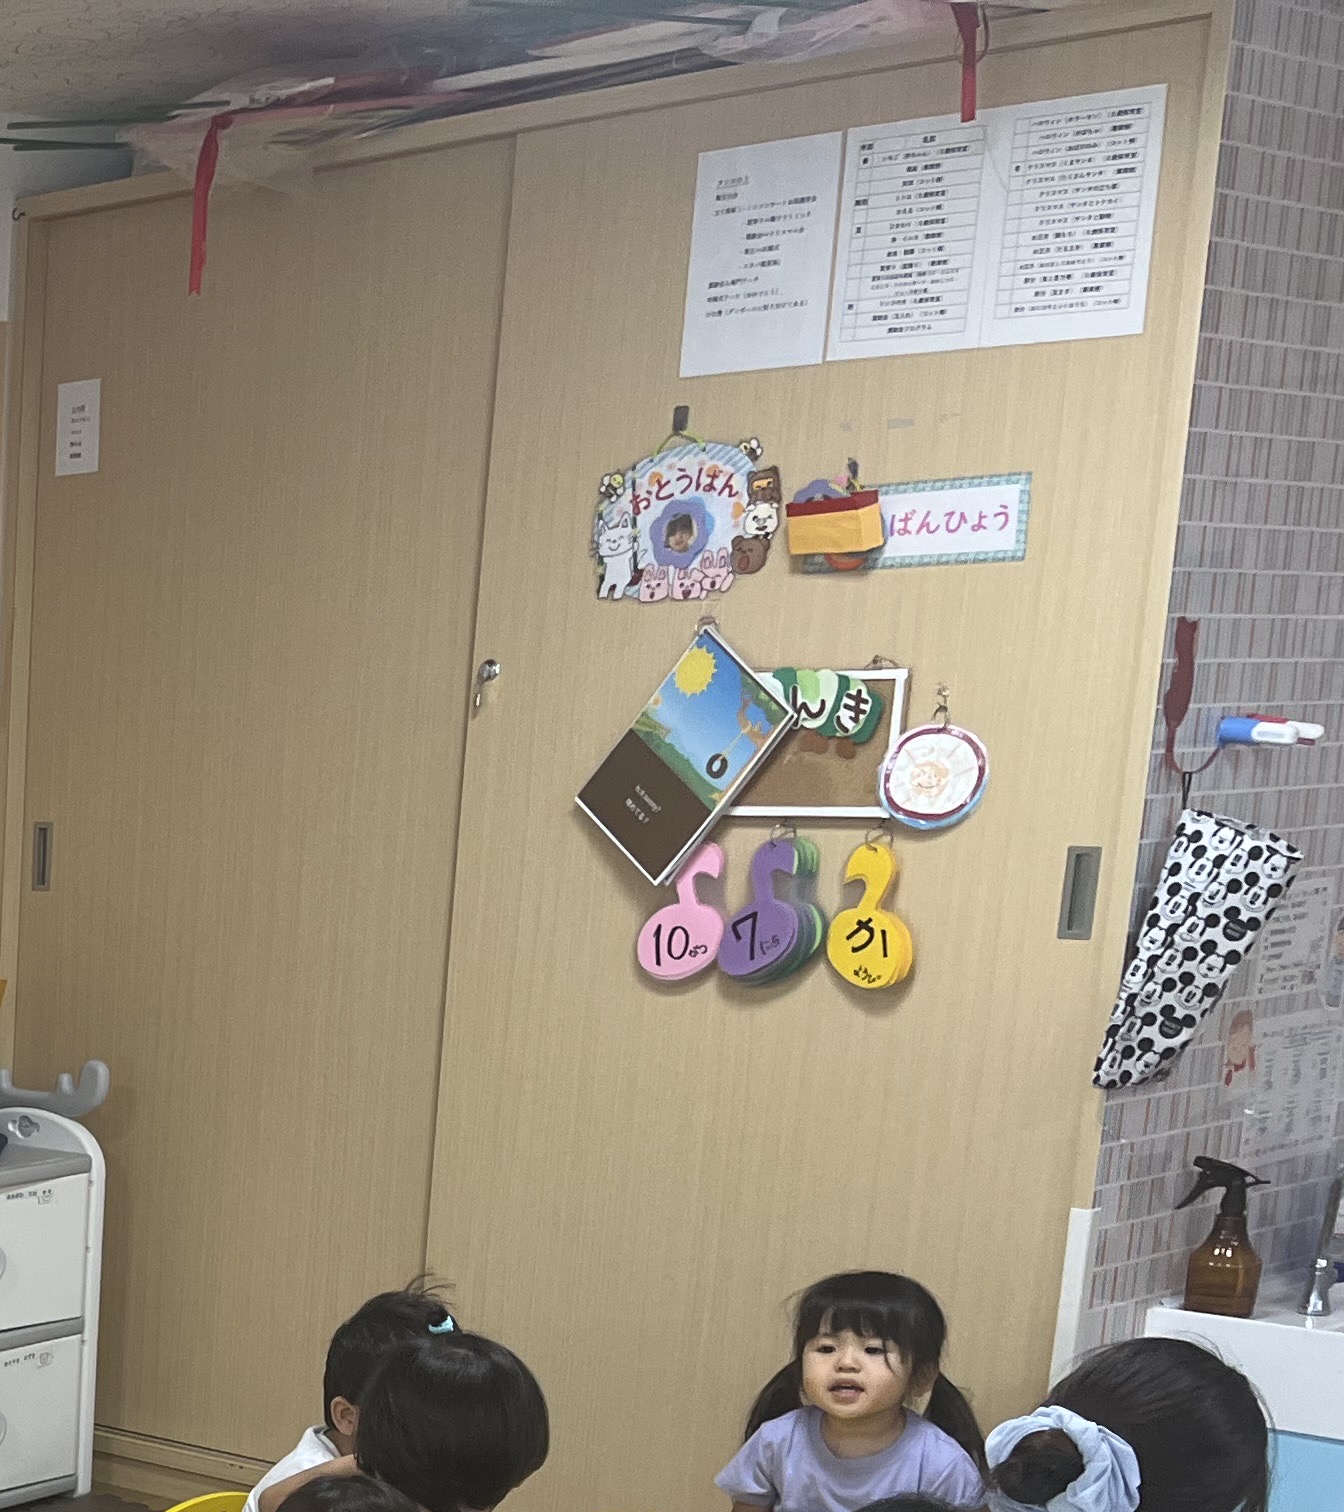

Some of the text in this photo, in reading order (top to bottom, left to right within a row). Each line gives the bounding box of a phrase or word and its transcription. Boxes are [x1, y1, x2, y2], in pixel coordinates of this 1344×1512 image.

[630, 467, 739, 516] おとうばん
